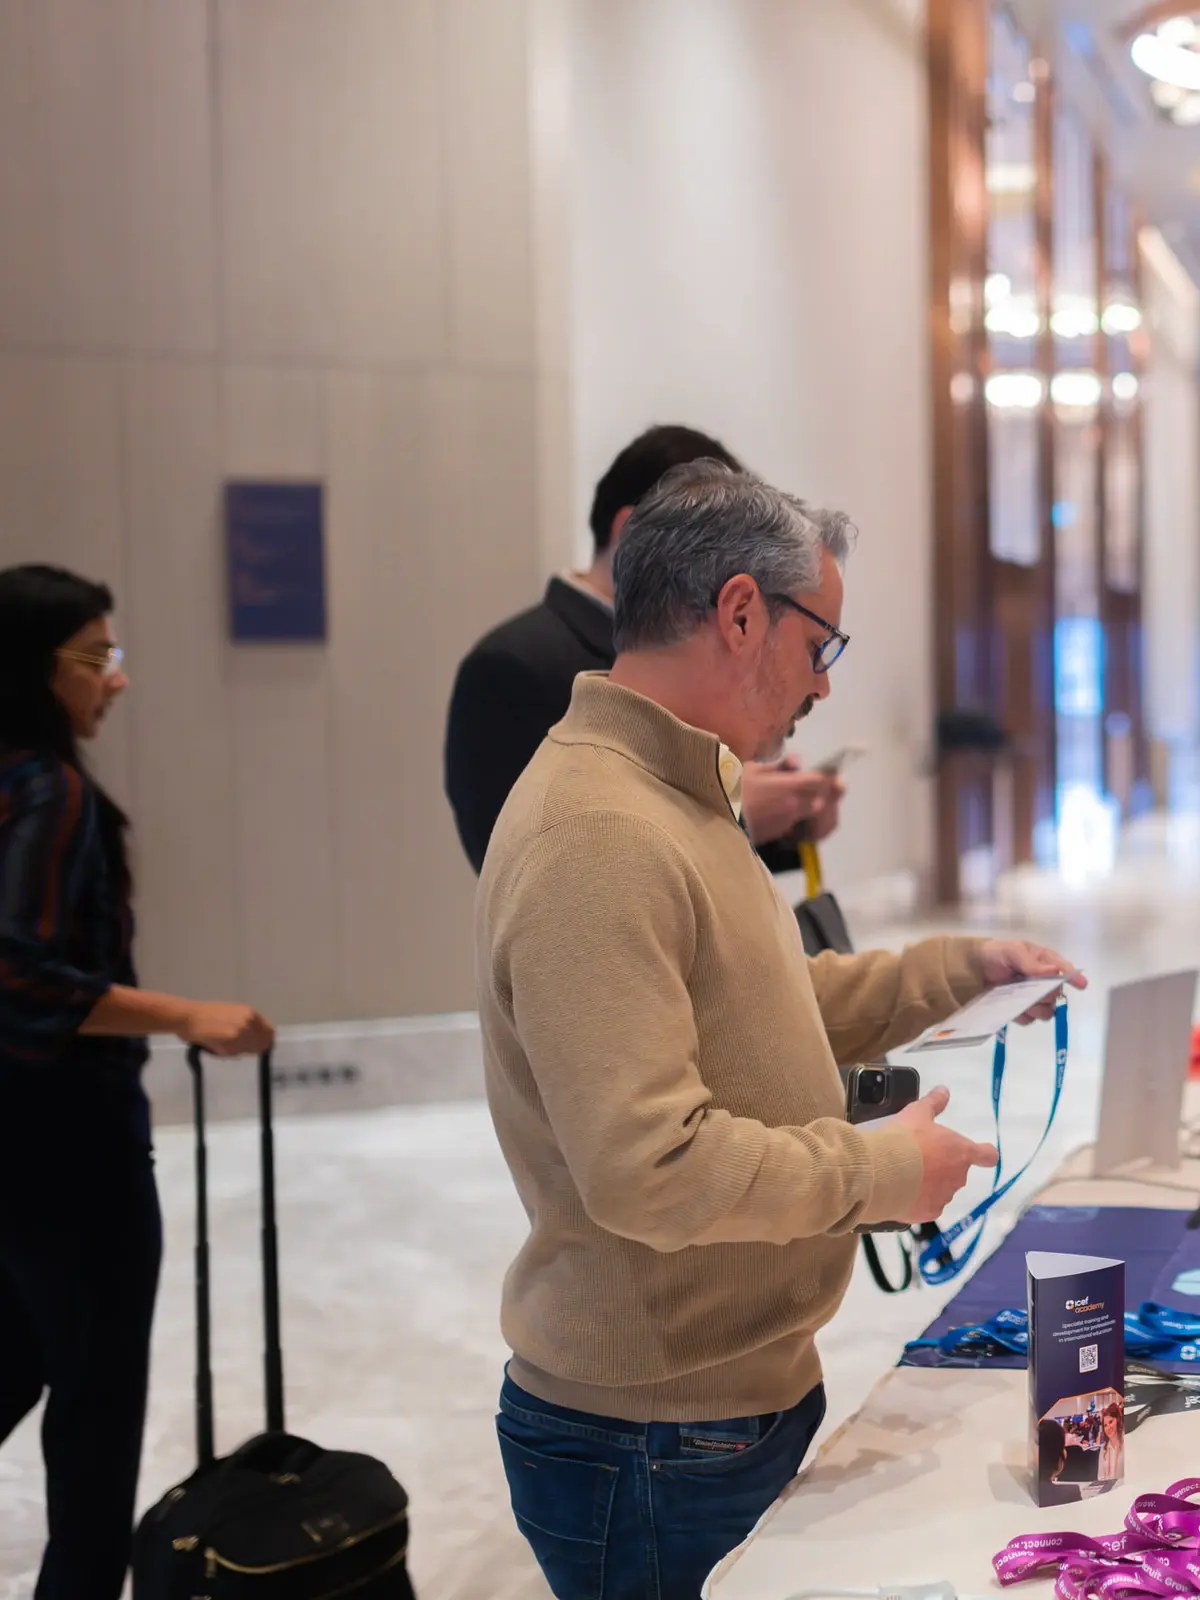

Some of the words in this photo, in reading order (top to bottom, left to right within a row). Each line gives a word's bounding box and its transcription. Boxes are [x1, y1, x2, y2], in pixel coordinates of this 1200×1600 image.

[1074, 1295, 1090, 1307] icef
[1074, 1302, 1105, 1314] academy
[1102, 1536, 1127, 1552] cef
